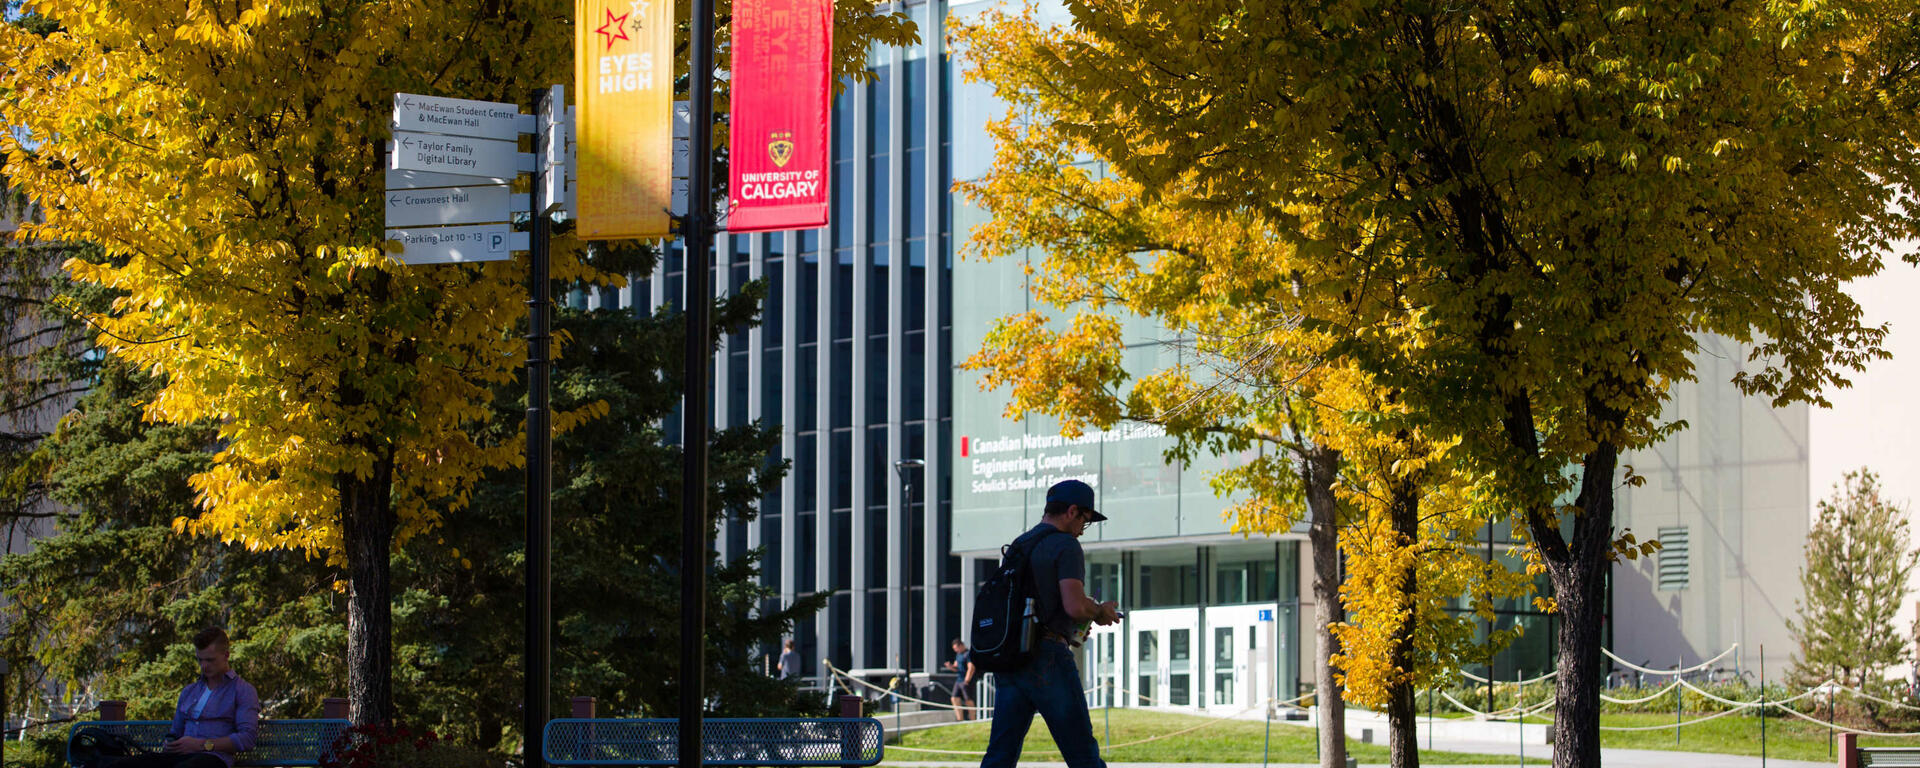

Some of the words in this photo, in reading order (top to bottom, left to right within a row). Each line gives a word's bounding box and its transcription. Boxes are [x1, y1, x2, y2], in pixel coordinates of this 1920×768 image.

[600, 53, 653, 74] EYES
[600, 72, 653, 94] HIGH
[418, 102, 455, 114] MacEwan
[456, 105, 487, 117] Student
[488, 109, 514, 120] Centre
[418, 113, 425, 122] &
[427, 114, 463, 126] MacEwan
[464, 118, 480, 127] Hall
[417, 140, 444, 152] Taylor
[446, 143, 473, 155] Family
[417, 153, 445, 165] Digital
[447, 155, 477, 168] Library
[742, 171, 802, 182] UNIVERSITY
[804, 170, 819, 180] OF
[741, 180, 819, 200] CALGARY
[405, 196, 449, 205] Crowsnest
[452, 194, 469, 203] Hall
[405, 234, 438, 245] Parking
[440, 233, 454, 242] Lot
[456, 233, 465, 242] 10
[473, 232, 482, 242] 13
[492, 235, 502, 249] P
[972, 436, 1021, 455] Canadian
[1023, 433, 1062, 449] Natural
[972, 456, 1036, 478] Engineering
[1037, 450, 1084, 472] Complex
[971, 478, 1007, 493] Schulich
[1007, 476, 1035, 491] School
[1036, 474, 1047, 489] of
